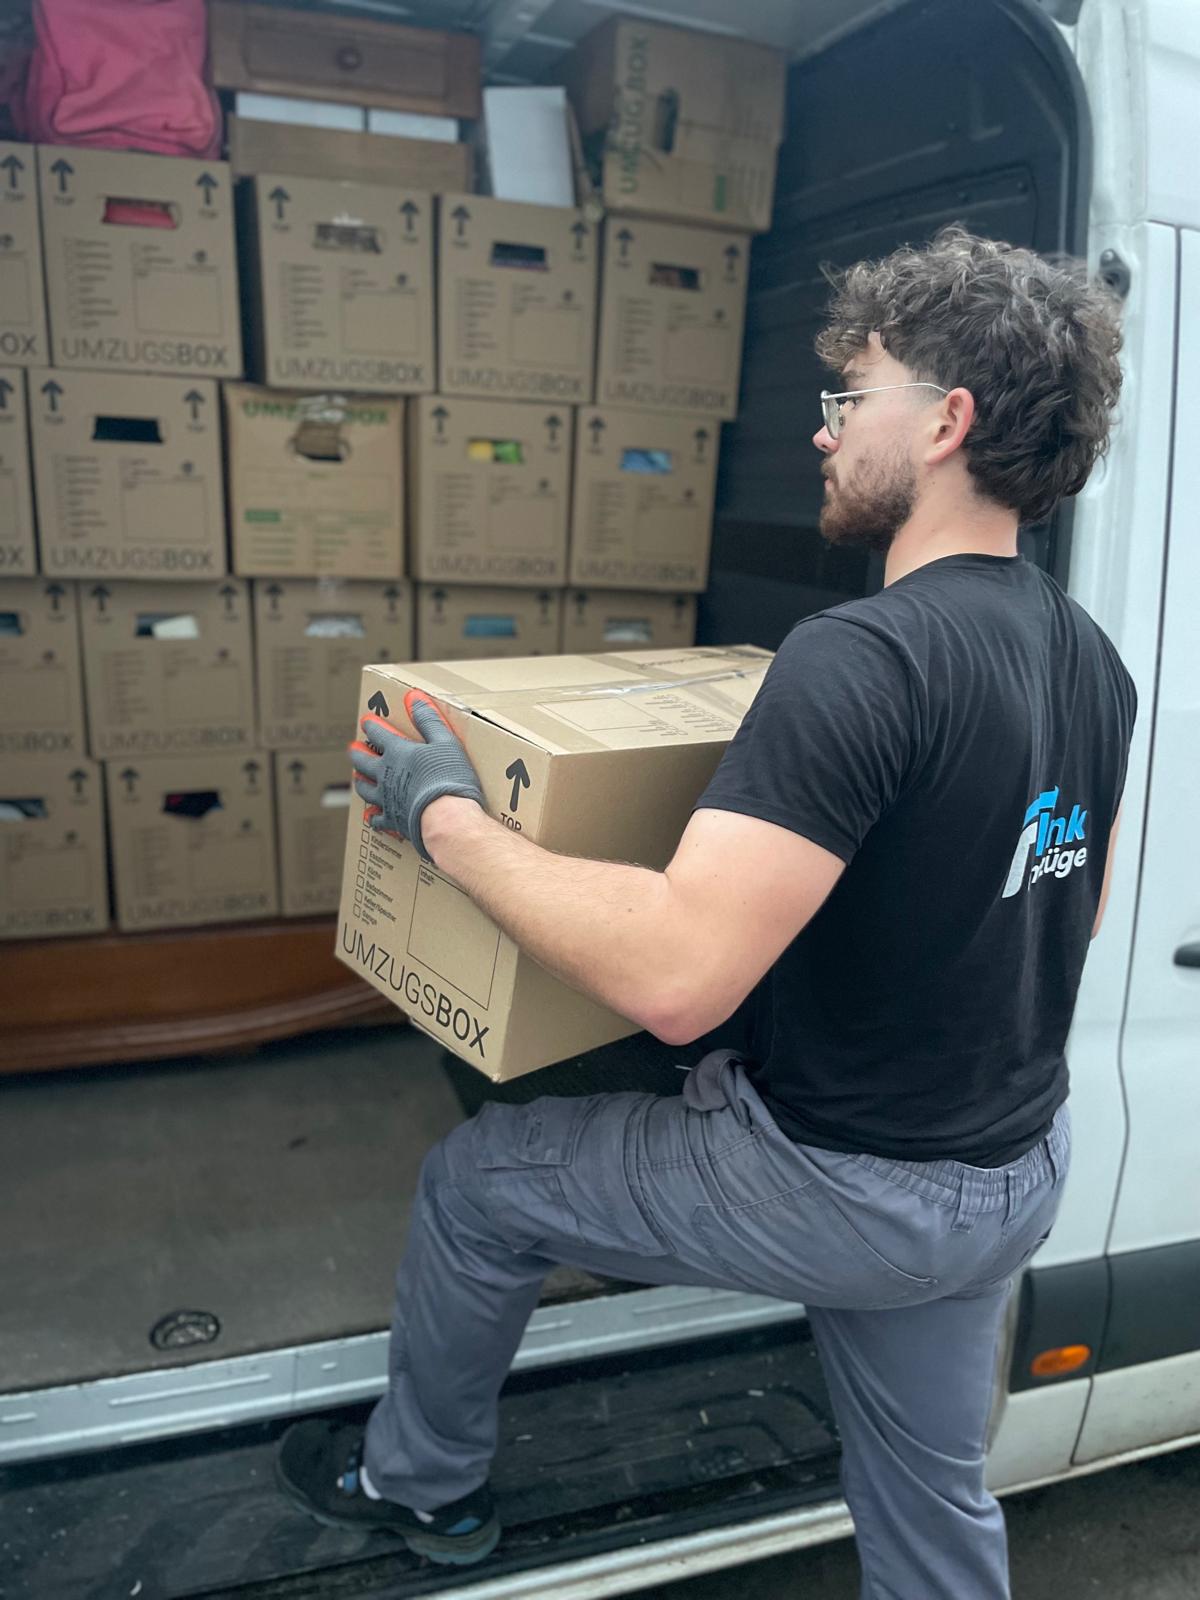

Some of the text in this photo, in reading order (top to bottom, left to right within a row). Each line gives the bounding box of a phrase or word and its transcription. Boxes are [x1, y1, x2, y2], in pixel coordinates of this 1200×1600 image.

[61, 337, 228, 368] UMZUGSBOX
[51, 546, 214, 571] UMZUGSBOX
[500, 812, 522, 831] TOP
[342, 922, 490, 1059] UMZUGSBOX
